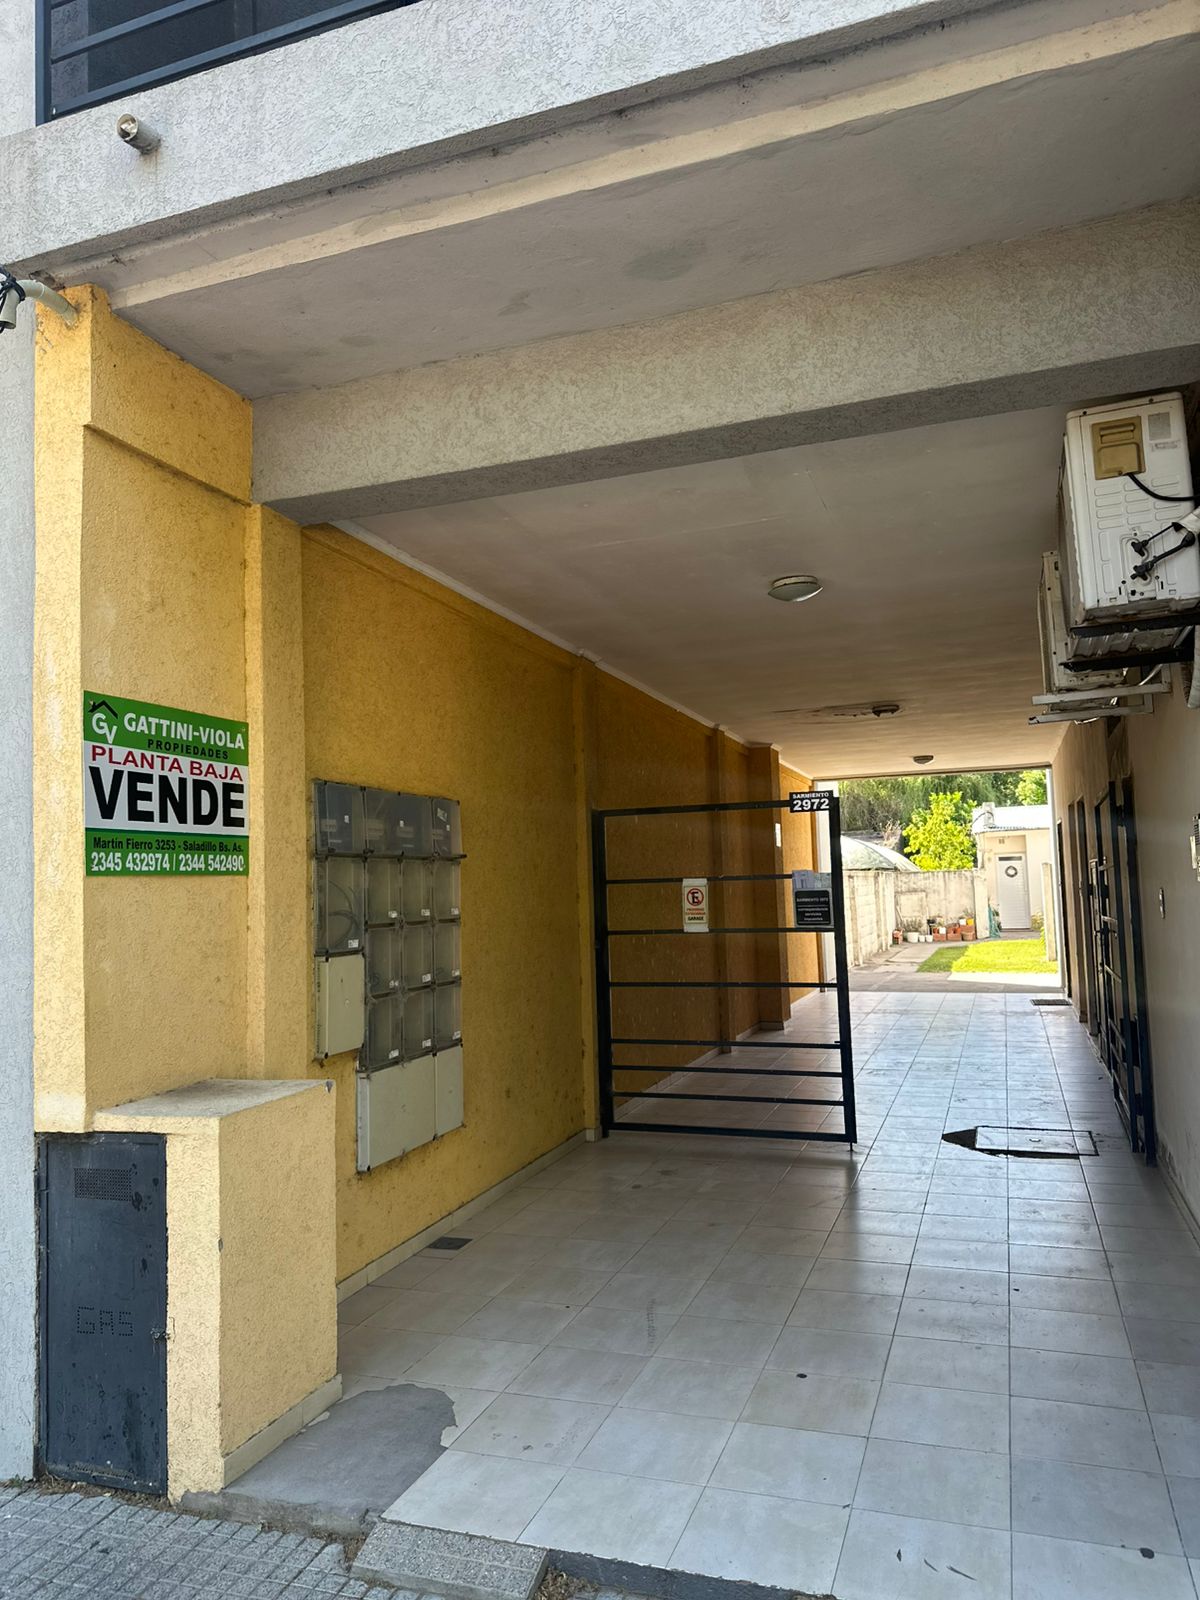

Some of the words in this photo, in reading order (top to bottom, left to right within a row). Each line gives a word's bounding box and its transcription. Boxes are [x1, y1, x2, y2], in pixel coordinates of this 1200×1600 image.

[123, 712, 245, 750] GATTINI-VIOLA
[147, 738, 229, 760] PROPIEDADES
[91, 744, 184, 774] PLANTA
[189, 760, 243, 782] BAJA
[88, 765, 245, 828] VENDE
[793, 798, 830, 811] 2972
[126, 838, 153, 851] Fierro
[155, 839, 176, 851] 3253
[182, 840, 216, 852] Saladillo
[218, 841, 230, 852] Bs.
[232, 842, 244, 852] As.
[91, 851, 122, 872] 2345
[125, 852, 170, 872] 432974
[178, 854, 206, 872] 2344
[207, 854, 244, 872] 542490
[77, 1306, 133, 1336] GAS
